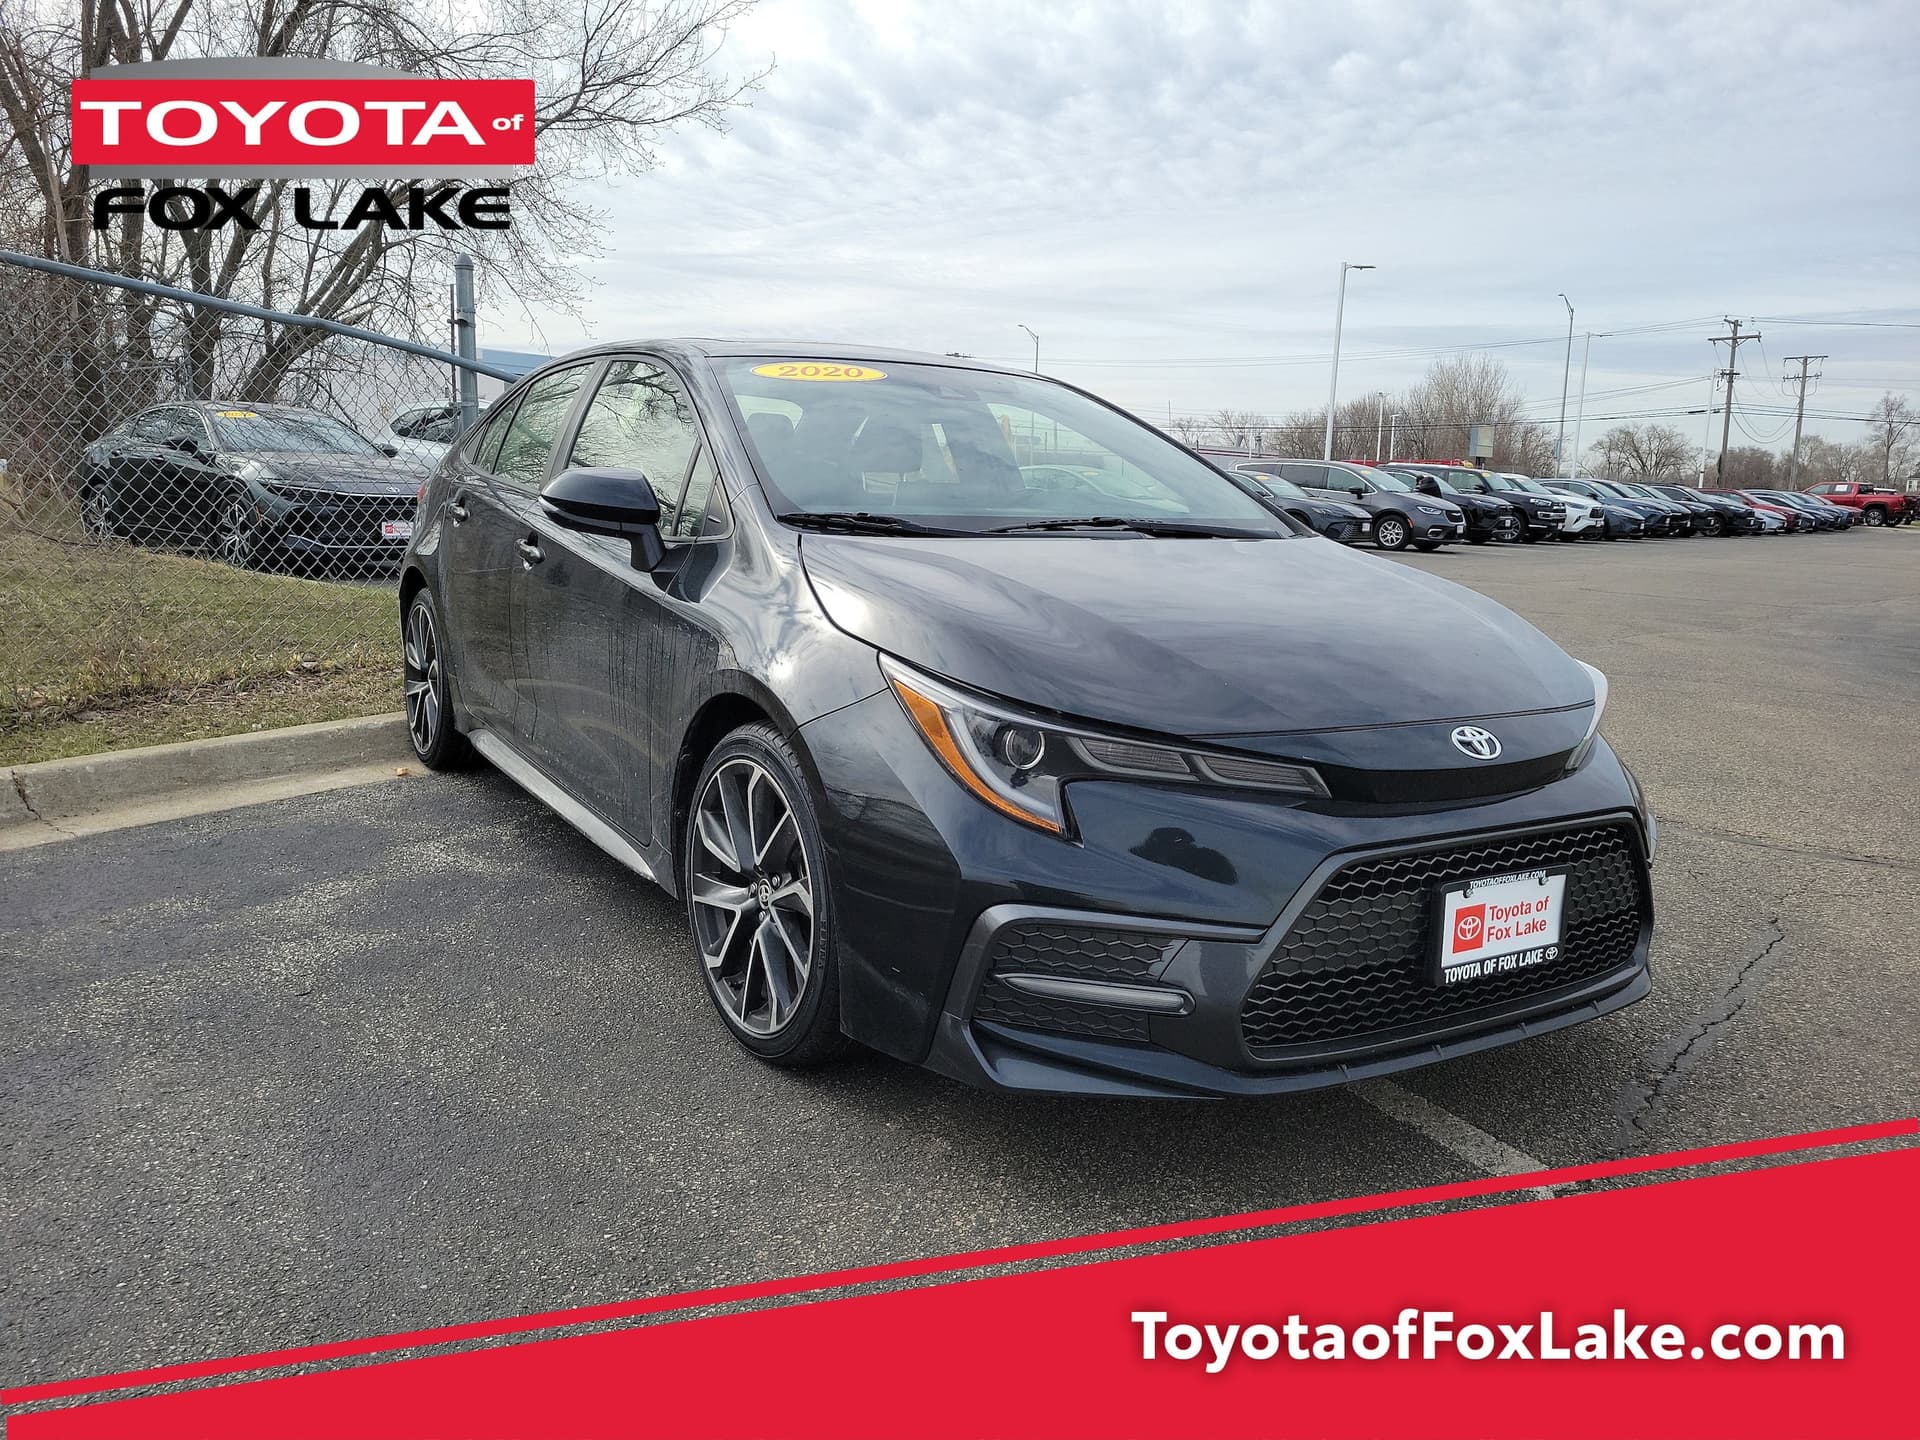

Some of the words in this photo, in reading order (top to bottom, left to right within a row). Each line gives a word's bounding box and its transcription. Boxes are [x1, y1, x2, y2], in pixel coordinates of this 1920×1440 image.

[778, 365, 864, 378] 2020
[1469, 870, 1547, 889] TOYOTAOFFOXLAKE.COM
[1489, 902, 1532, 923] Toyota
[1535, 896, 1550, 913] of
[1487, 925, 1512, 943] Fox
[1515, 918, 1547, 937] Lake
[1444, 964, 1482, 984] TOYOTA
[1483, 958, 1497, 975] OF
[1498, 954, 1518, 971] FOX
[1519, 948, 1544, 967] LAKE
